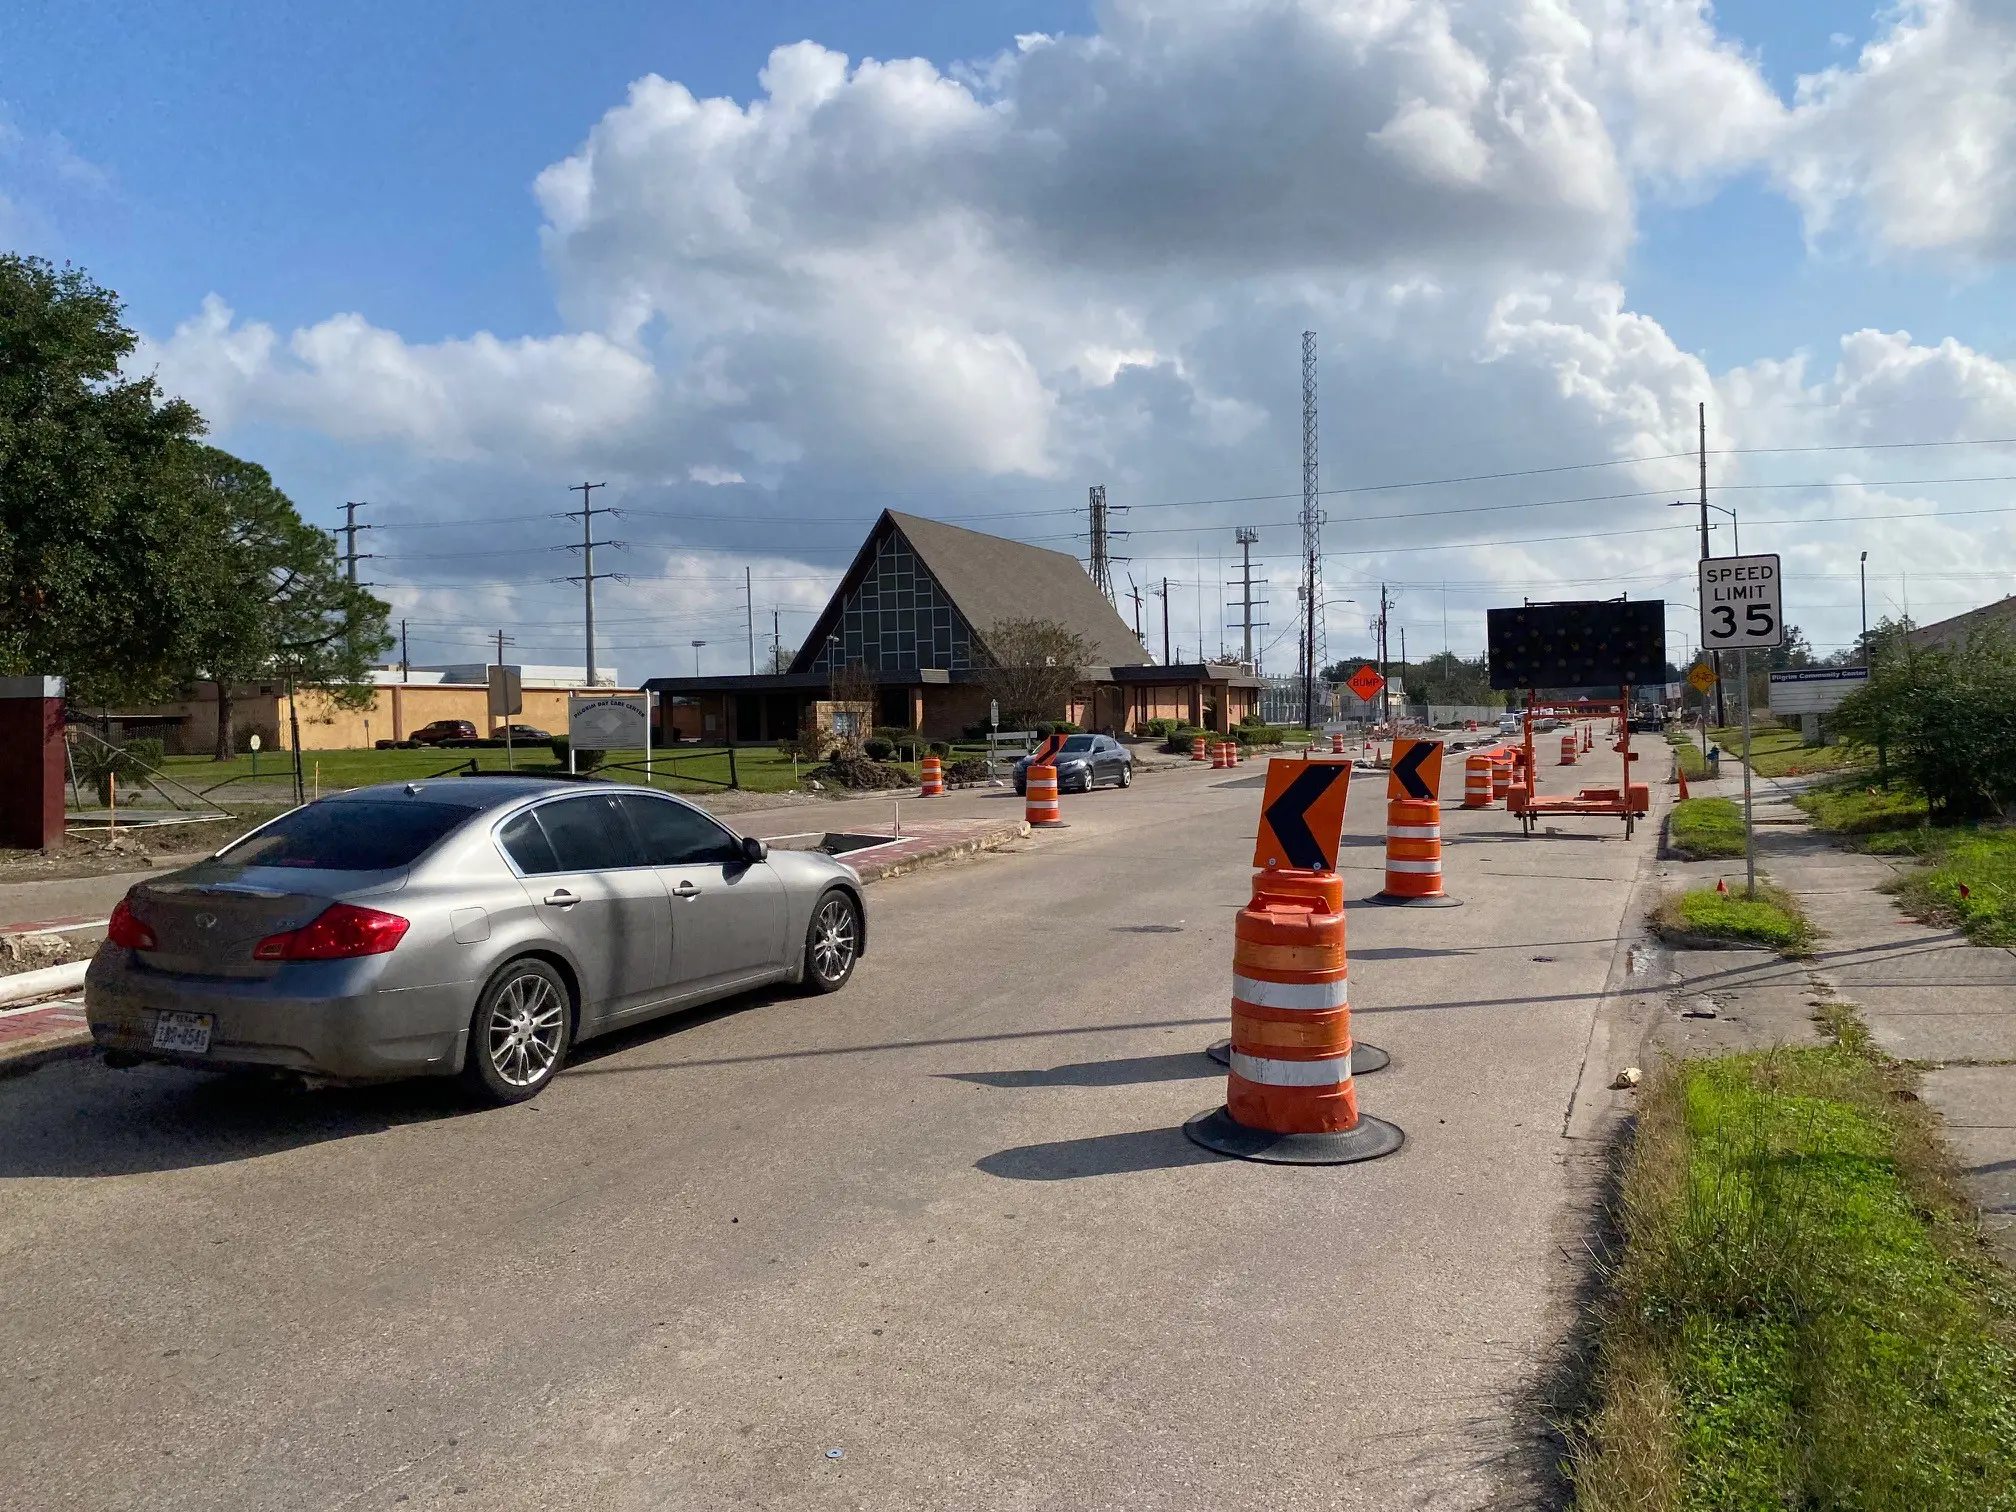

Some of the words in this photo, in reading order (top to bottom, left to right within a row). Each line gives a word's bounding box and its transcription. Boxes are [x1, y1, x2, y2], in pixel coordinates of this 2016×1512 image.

[1706, 565, 1773, 583] SPEED
[1714, 584, 1766, 601] LIMIT
[1709, 603, 1774, 639] 35
[1352, 677, 1380, 687] BUMP
[1771, 673, 1798, 682] Pilgrim
[1799, 671, 1840, 679] Community
[573, 703, 597, 718] PILGRIM
[625, 703, 646, 718] CENTER
